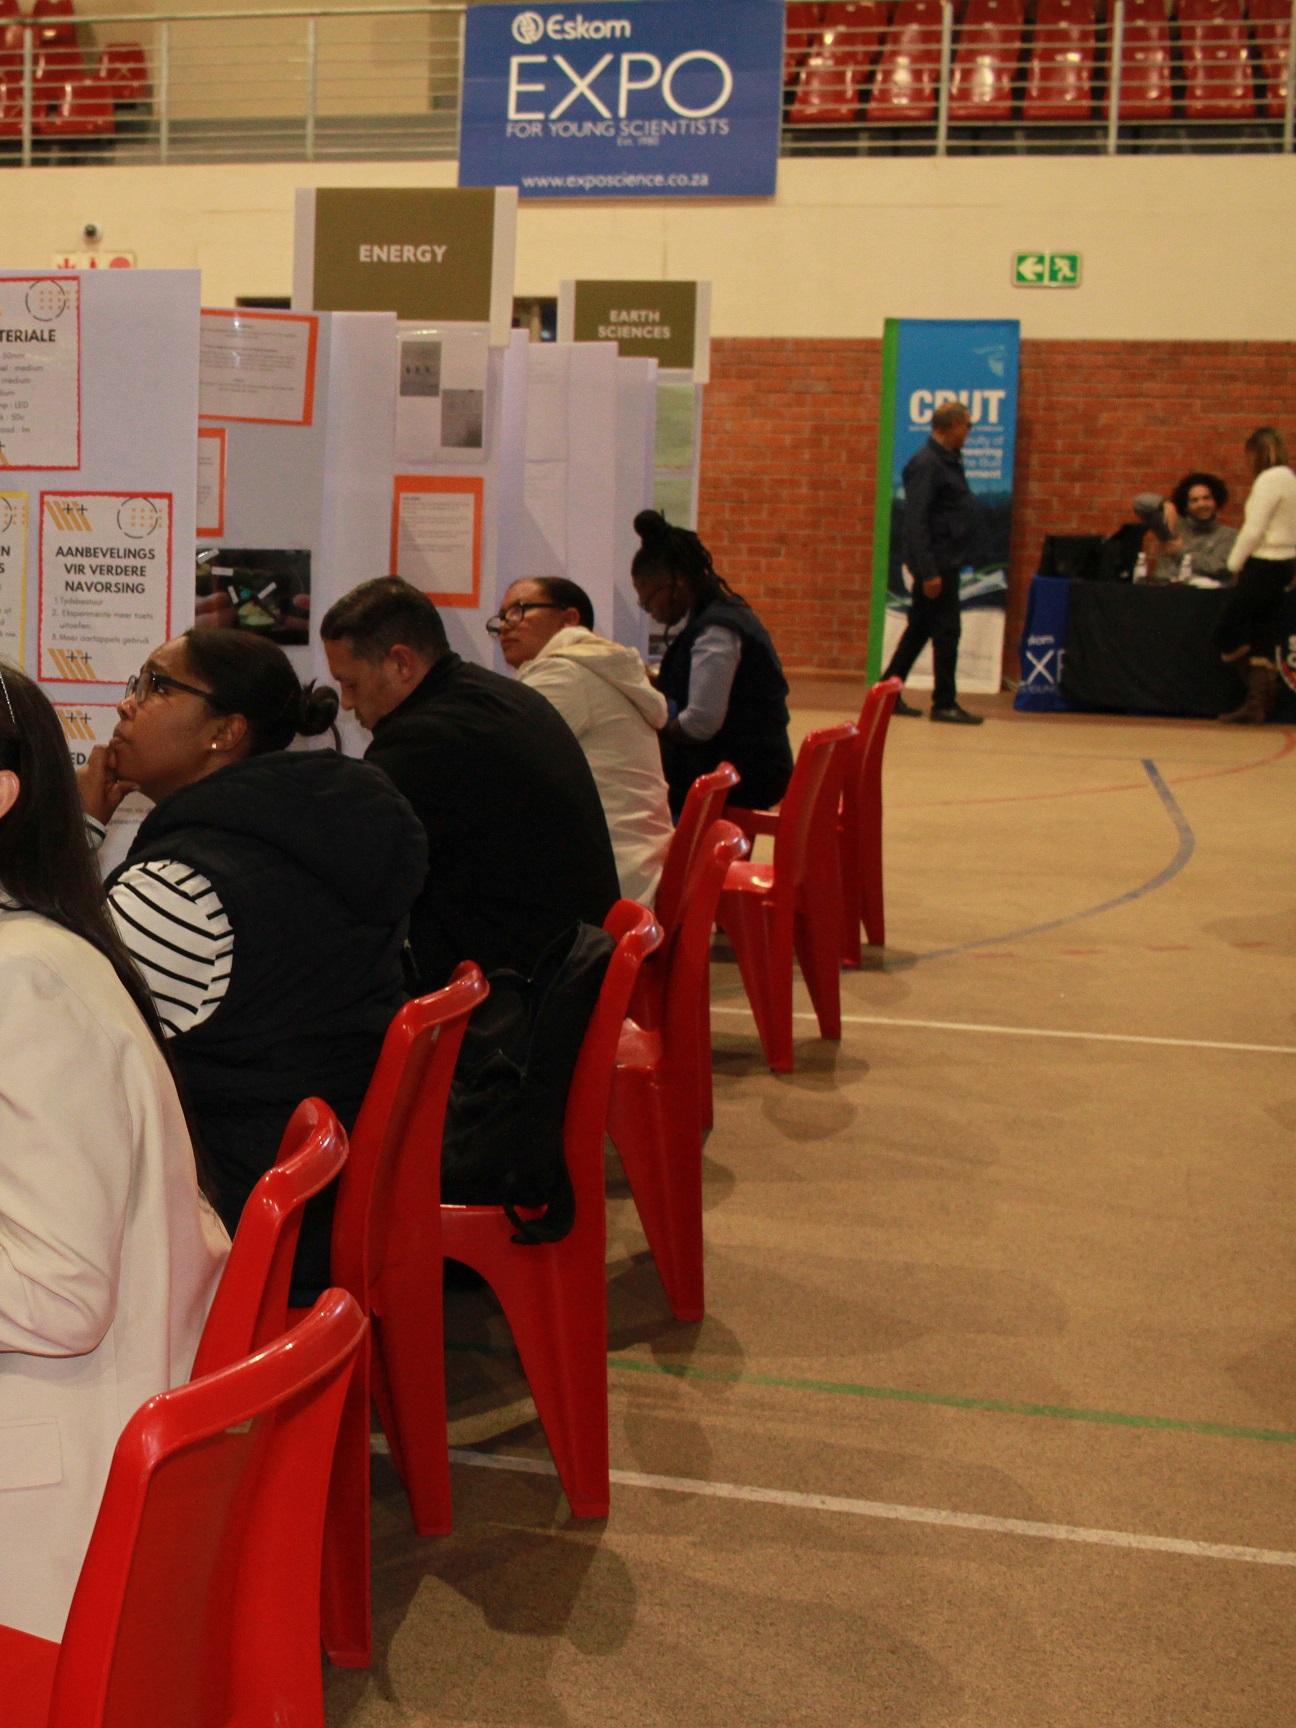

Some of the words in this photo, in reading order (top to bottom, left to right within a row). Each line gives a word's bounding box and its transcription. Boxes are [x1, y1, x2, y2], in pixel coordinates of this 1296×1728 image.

[547, 14, 630, 39] Eskom
[508, 50, 733, 120] EXPO
[506, 122, 542, 138] FOR
[550, 120, 615, 137] YOUNG
[620, 118, 729, 136] SCIENTISTS
[521, 172, 708, 190] www.exposcience.co.za
[359, 245, 447, 263] ENERGY
[609, 309, 660, 323] EARTH
[597, 325, 670, 339] SCIENCES
[55, 546, 155, 559] AANBEVELINGS
[64, 563, 85, 575] VIR
[89, 564, 146, 577] VERDERE
[65, 581, 145, 593] NAVORSING
